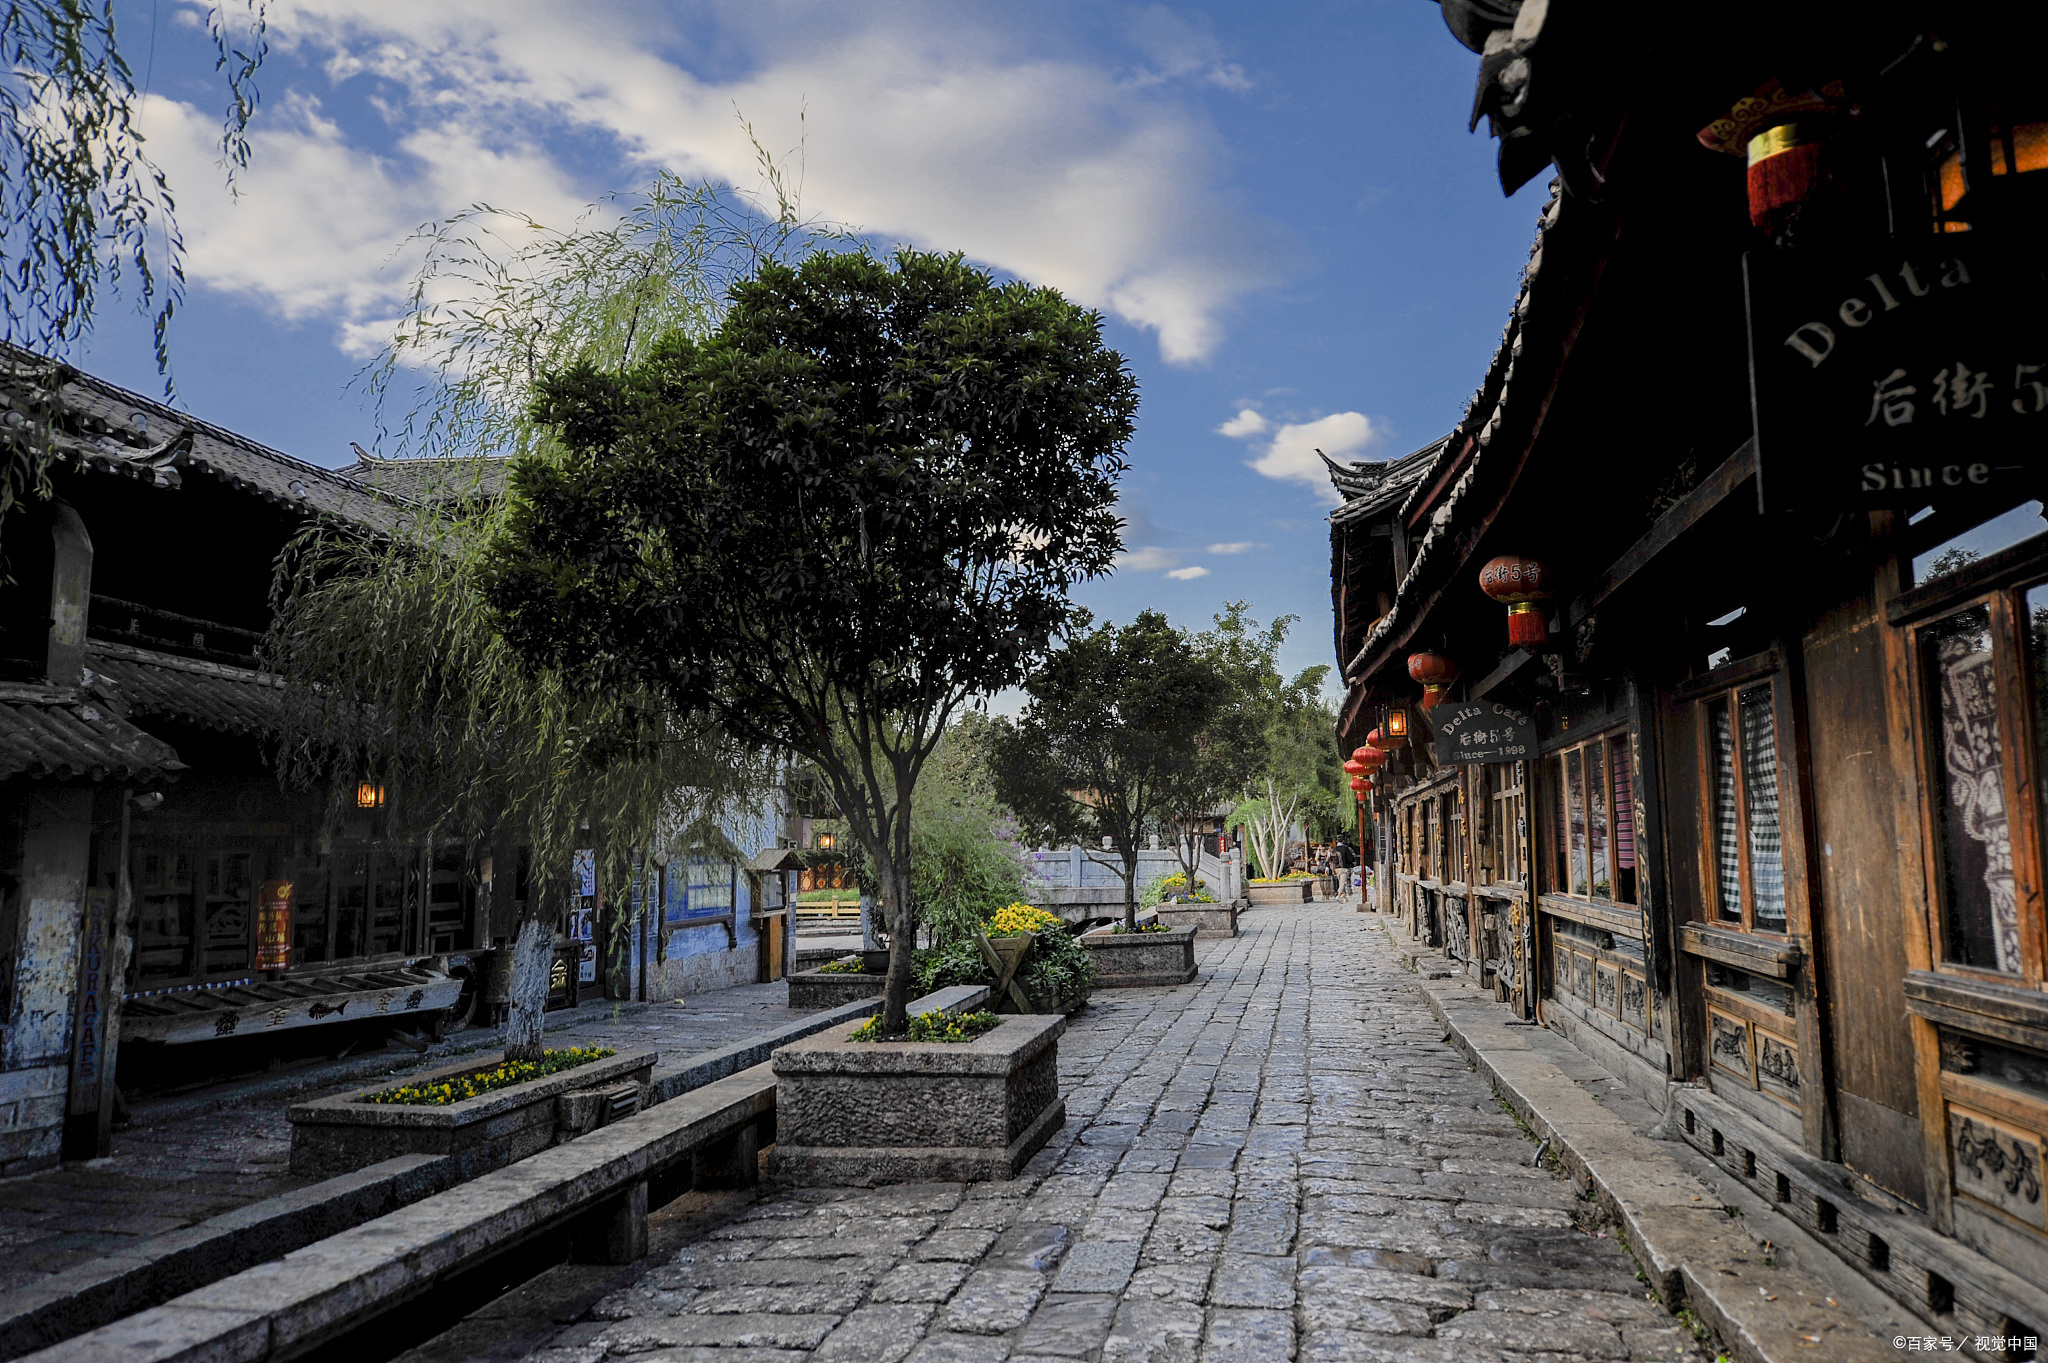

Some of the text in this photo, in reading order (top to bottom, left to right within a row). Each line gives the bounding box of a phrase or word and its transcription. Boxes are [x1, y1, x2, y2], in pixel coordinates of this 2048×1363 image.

[1784, 258, 1971, 369] Delta
[1864, 361, 2048, 428] 后街5
[1484, 562, 1540, 585] 后街5号
[1441, 707, 1482, 736] Delta
[1460, 726, 1516, 747] 后街5号
